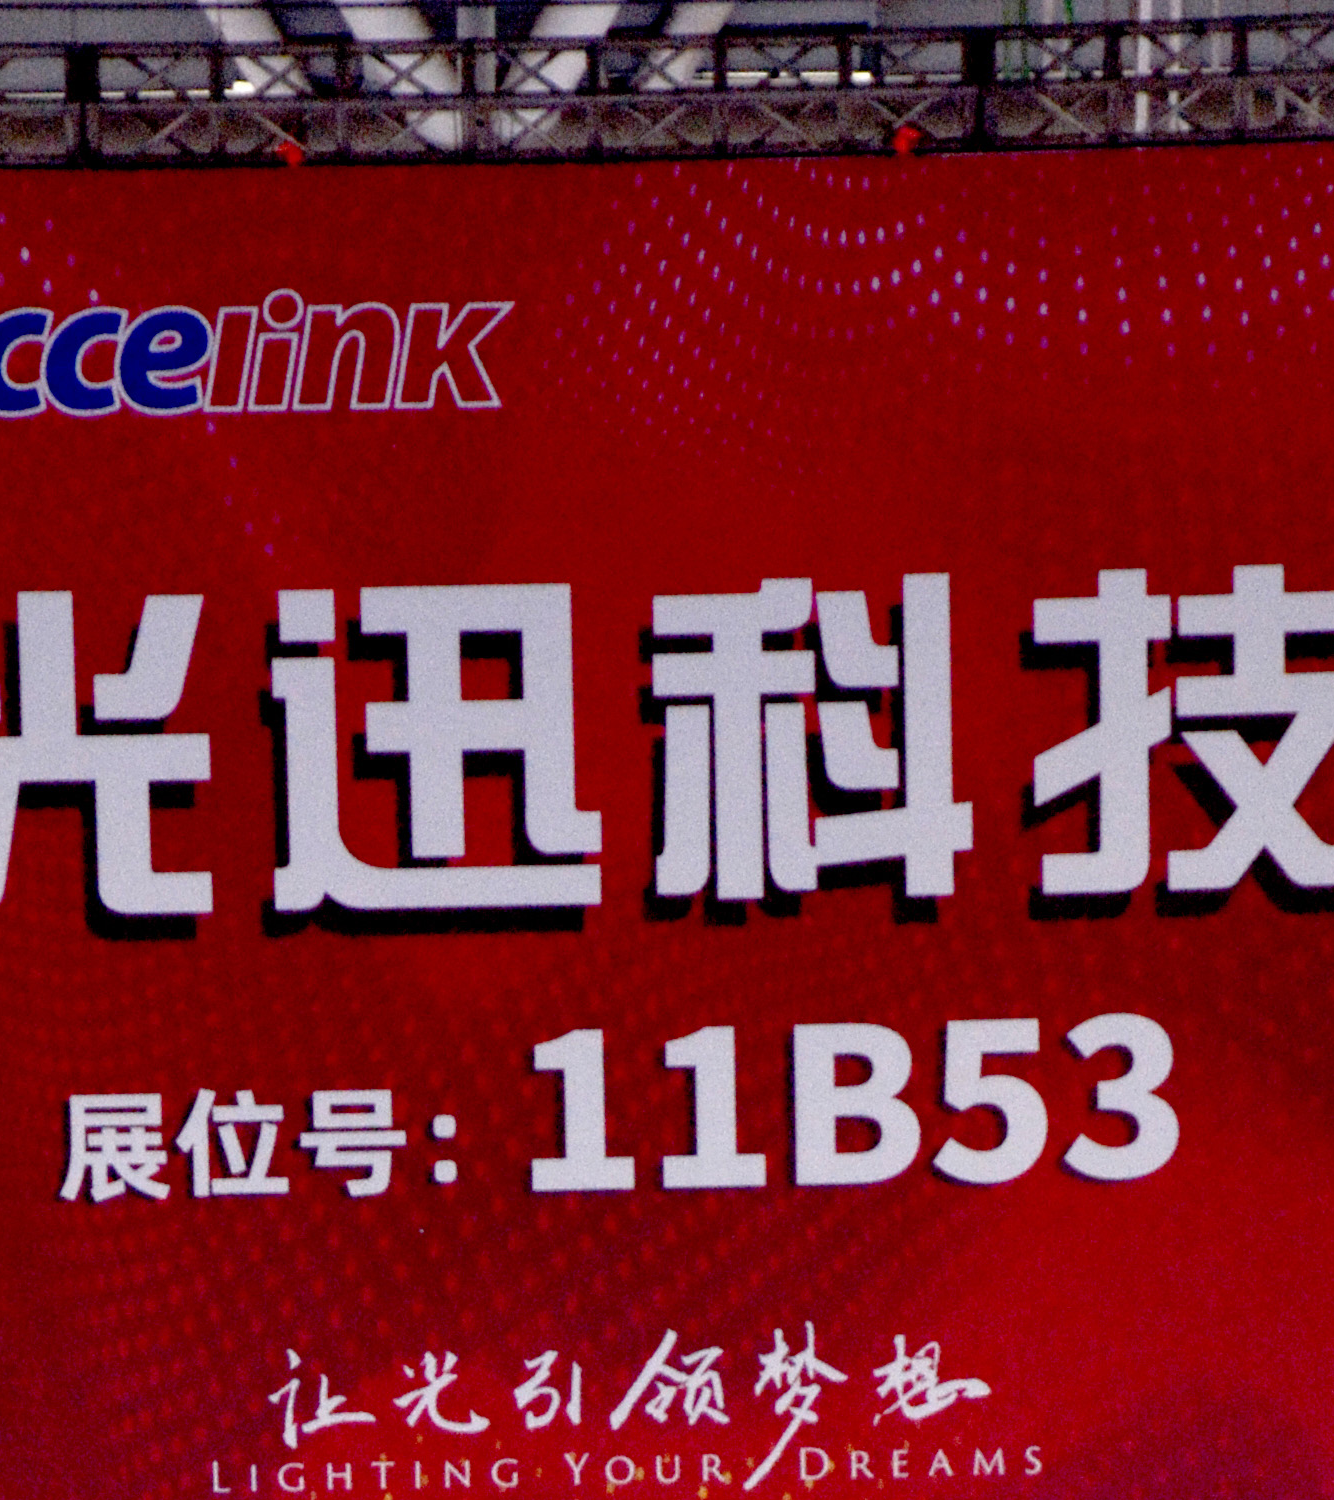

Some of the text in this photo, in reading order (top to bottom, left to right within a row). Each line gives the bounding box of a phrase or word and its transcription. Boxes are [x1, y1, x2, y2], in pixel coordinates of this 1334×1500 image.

[529, 1016, 1178, 1192] 11B53
[269, 1321, 990, 1489] 让光引领梦想
